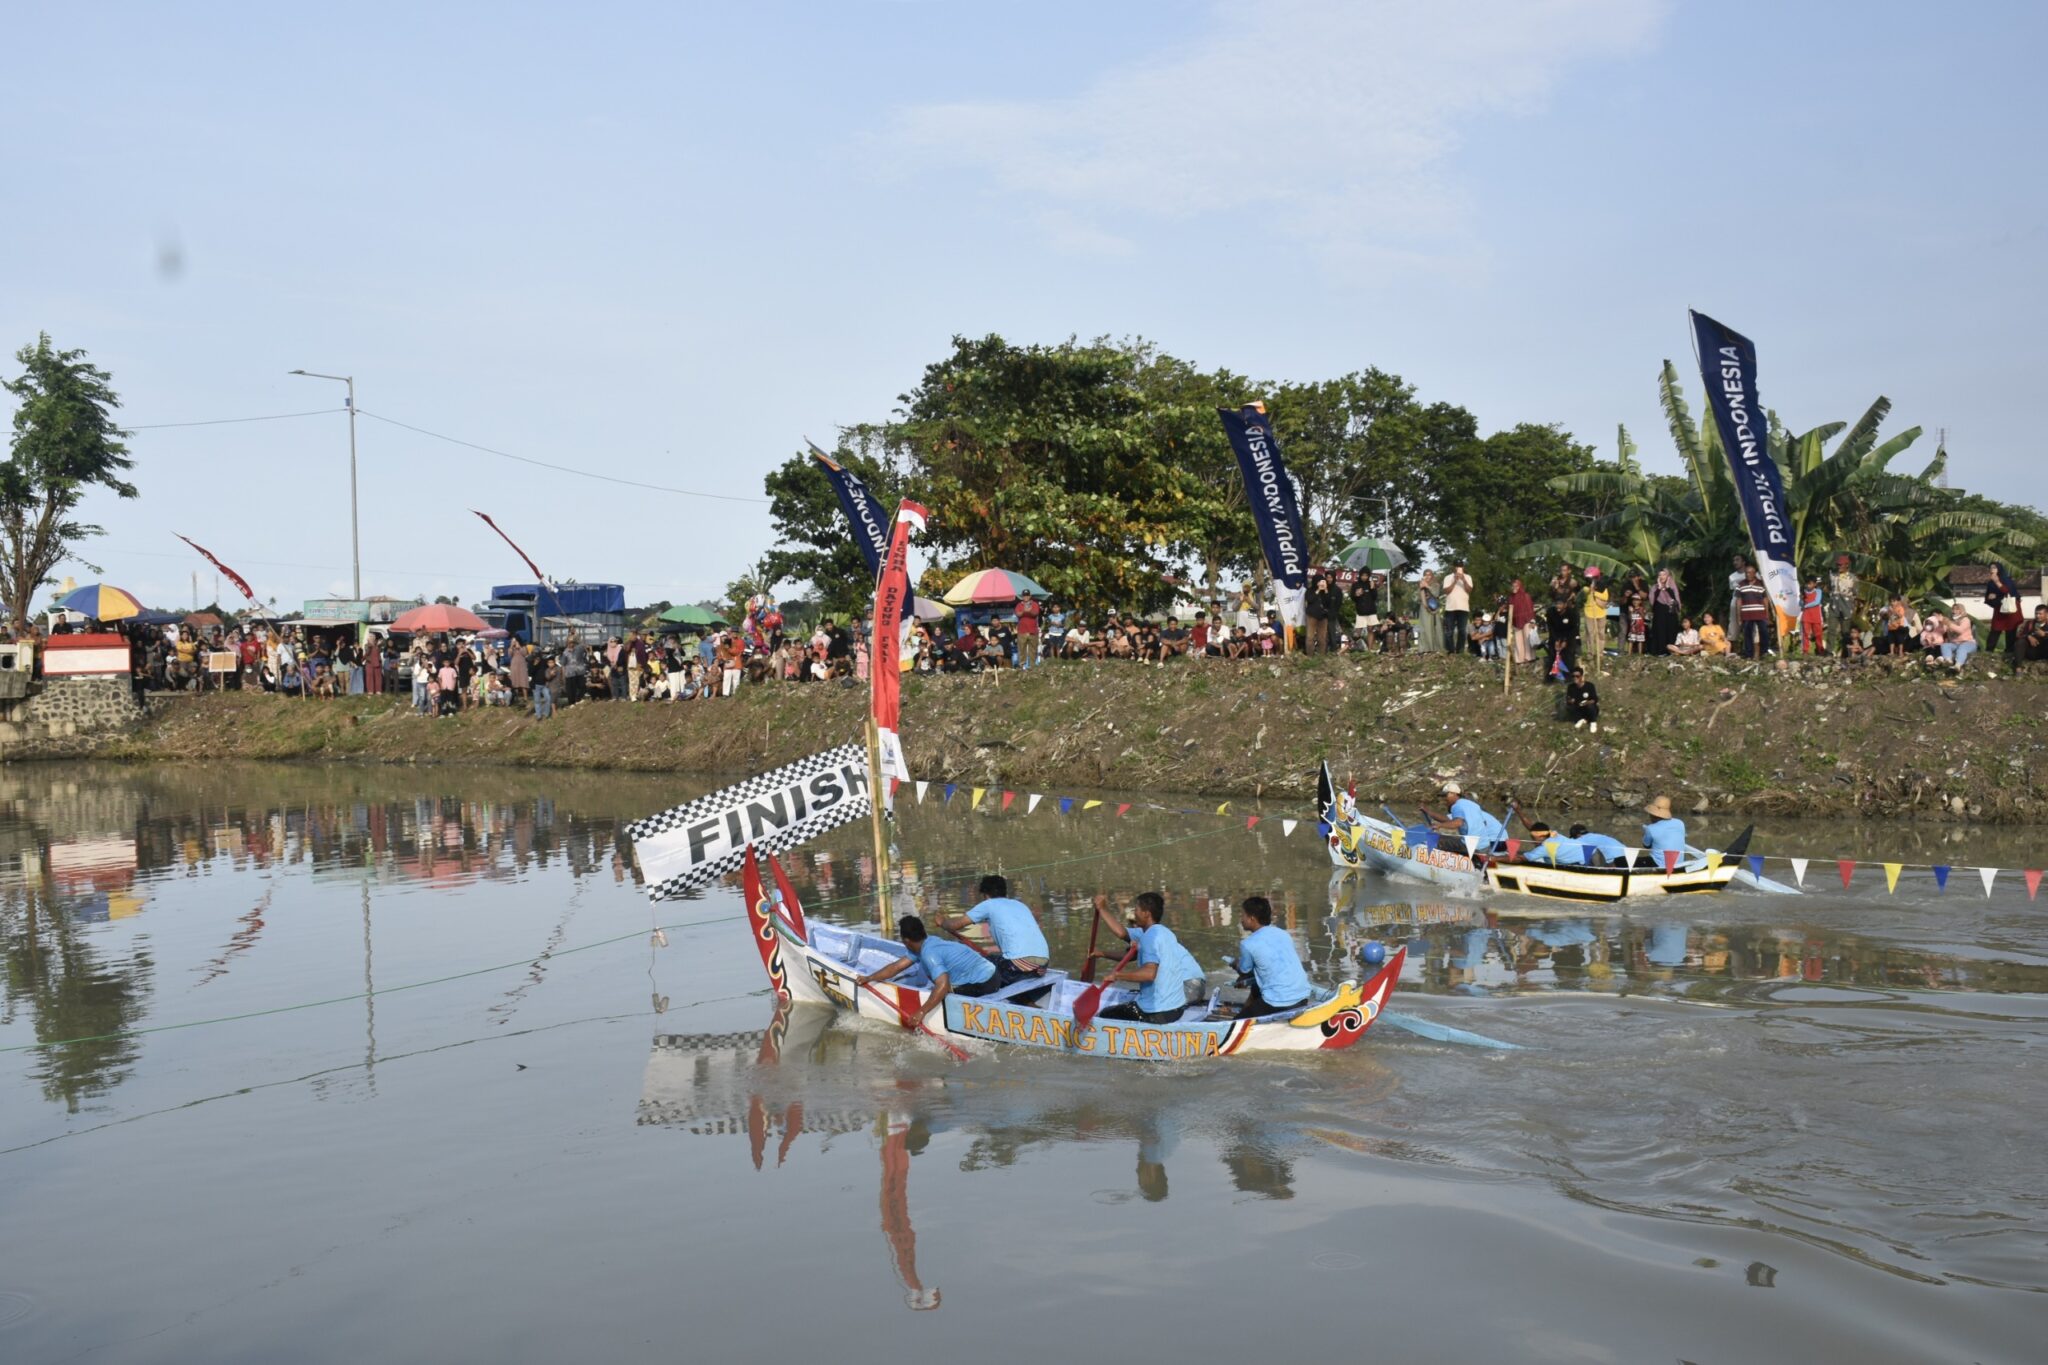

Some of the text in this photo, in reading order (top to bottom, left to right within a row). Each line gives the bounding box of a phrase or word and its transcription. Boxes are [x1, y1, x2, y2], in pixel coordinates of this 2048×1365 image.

[1245, 425, 1284, 514] INDONESIA
[1719, 346, 1787, 544] PUPUK INDONESIA
[842, 477, 889, 552] INDONES
[1272, 518, 1302, 575] PUPUK
[881, 587, 897, 625] DAYUNG
[687, 765, 868, 865] FINISH
[1365, 830, 1473, 872] LANGEN HARJO
[962, 1003, 1219, 1059] KARANG TARUNA
